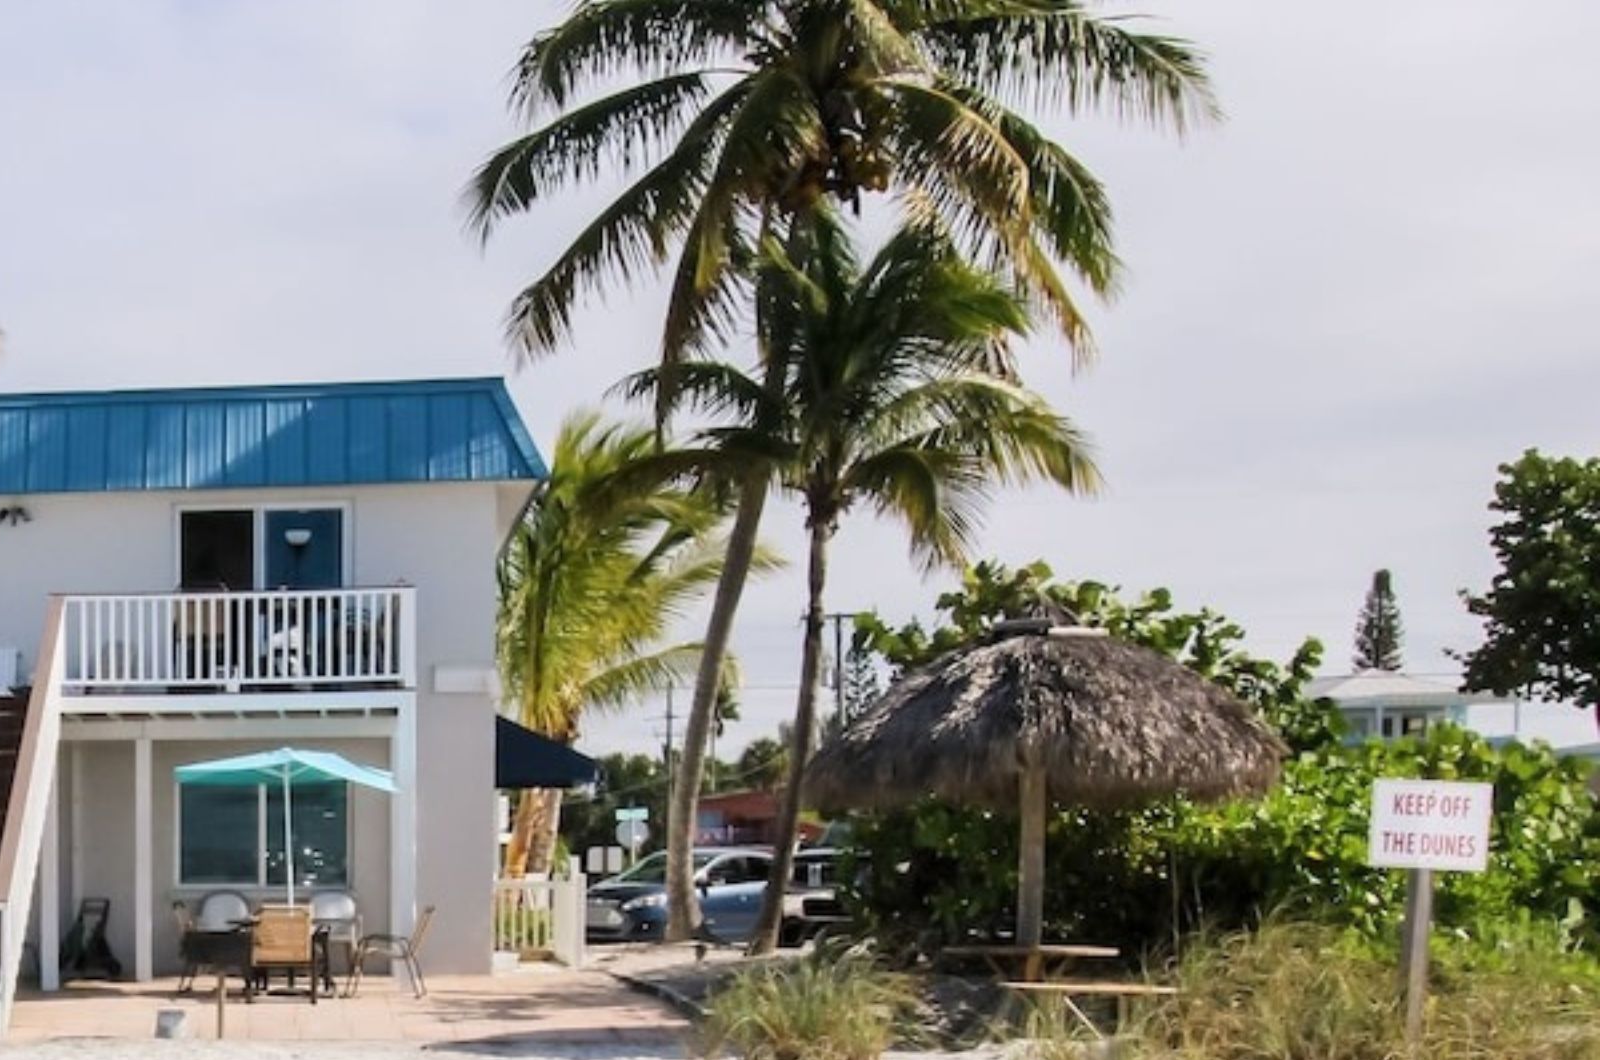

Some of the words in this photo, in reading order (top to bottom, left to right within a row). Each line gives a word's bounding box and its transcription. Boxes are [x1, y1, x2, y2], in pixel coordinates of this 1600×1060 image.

[1393, 793, 1437, 816] KEEP
[1440, 795, 1471, 818] OFF
[1383, 831, 1415, 855] THE
[1420, 832, 1476, 858] DUNES
